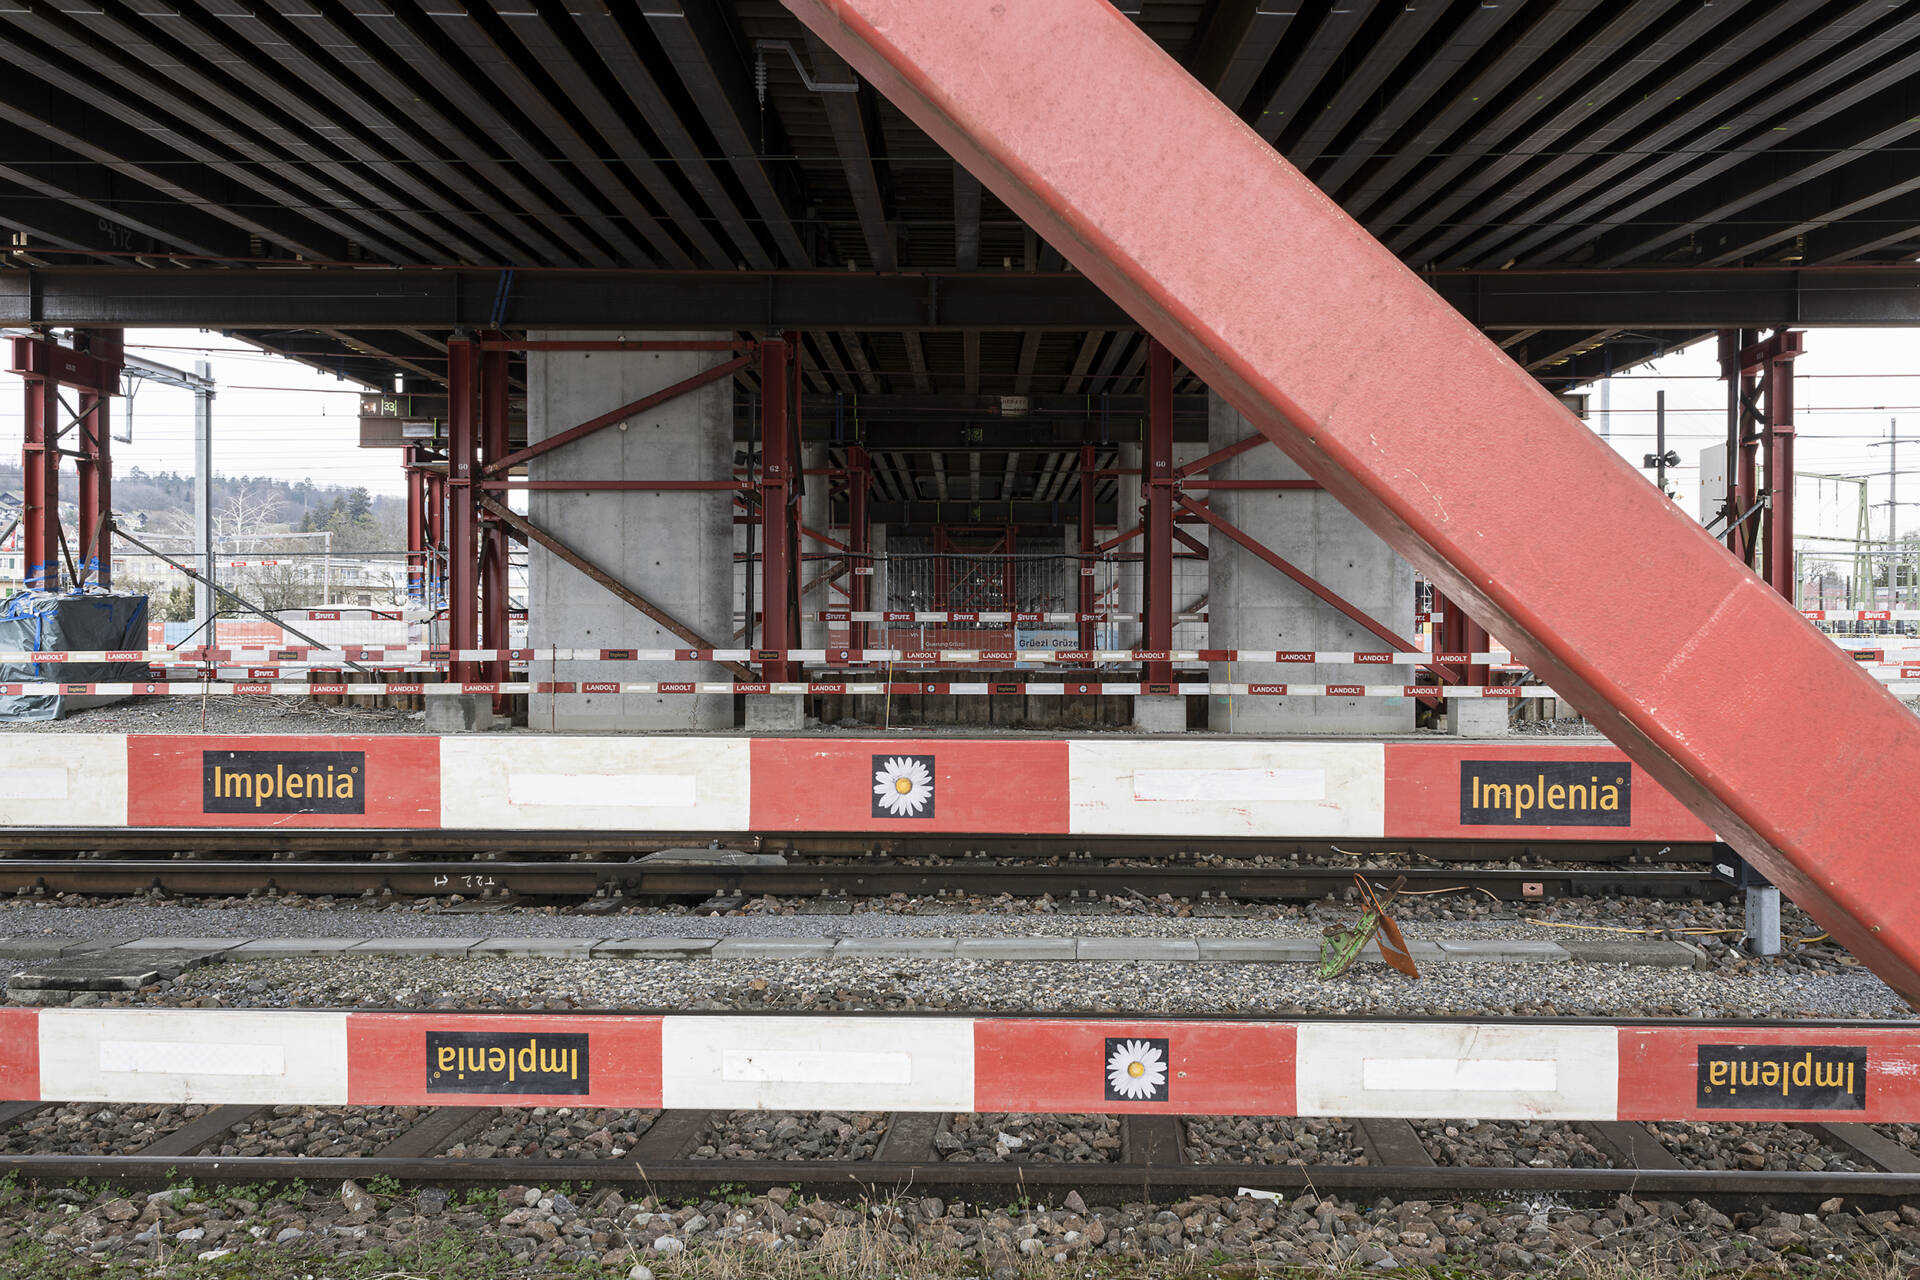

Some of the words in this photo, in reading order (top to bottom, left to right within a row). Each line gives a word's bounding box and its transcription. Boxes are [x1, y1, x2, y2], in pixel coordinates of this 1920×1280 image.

[314, 612, 336, 620] STUTZ
[825, 612, 847, 620] STUTZ
[889, 613, 911, 621] STUTZ
[953, 613, 975, 621] STUTZ
[1252, 684, 1284, 692] LANDOLT
[1407, 687, 1438, 695] LANDOLT
[1484, 687, 1516, 695] LANDOLT
[214, 763, 354, 807] Implenia
[1472, 774, 1619, 819] Implenia
[437, 1038, 578, 1082] Implenia
[1709, 1052, 1855, 1096] Implenia
